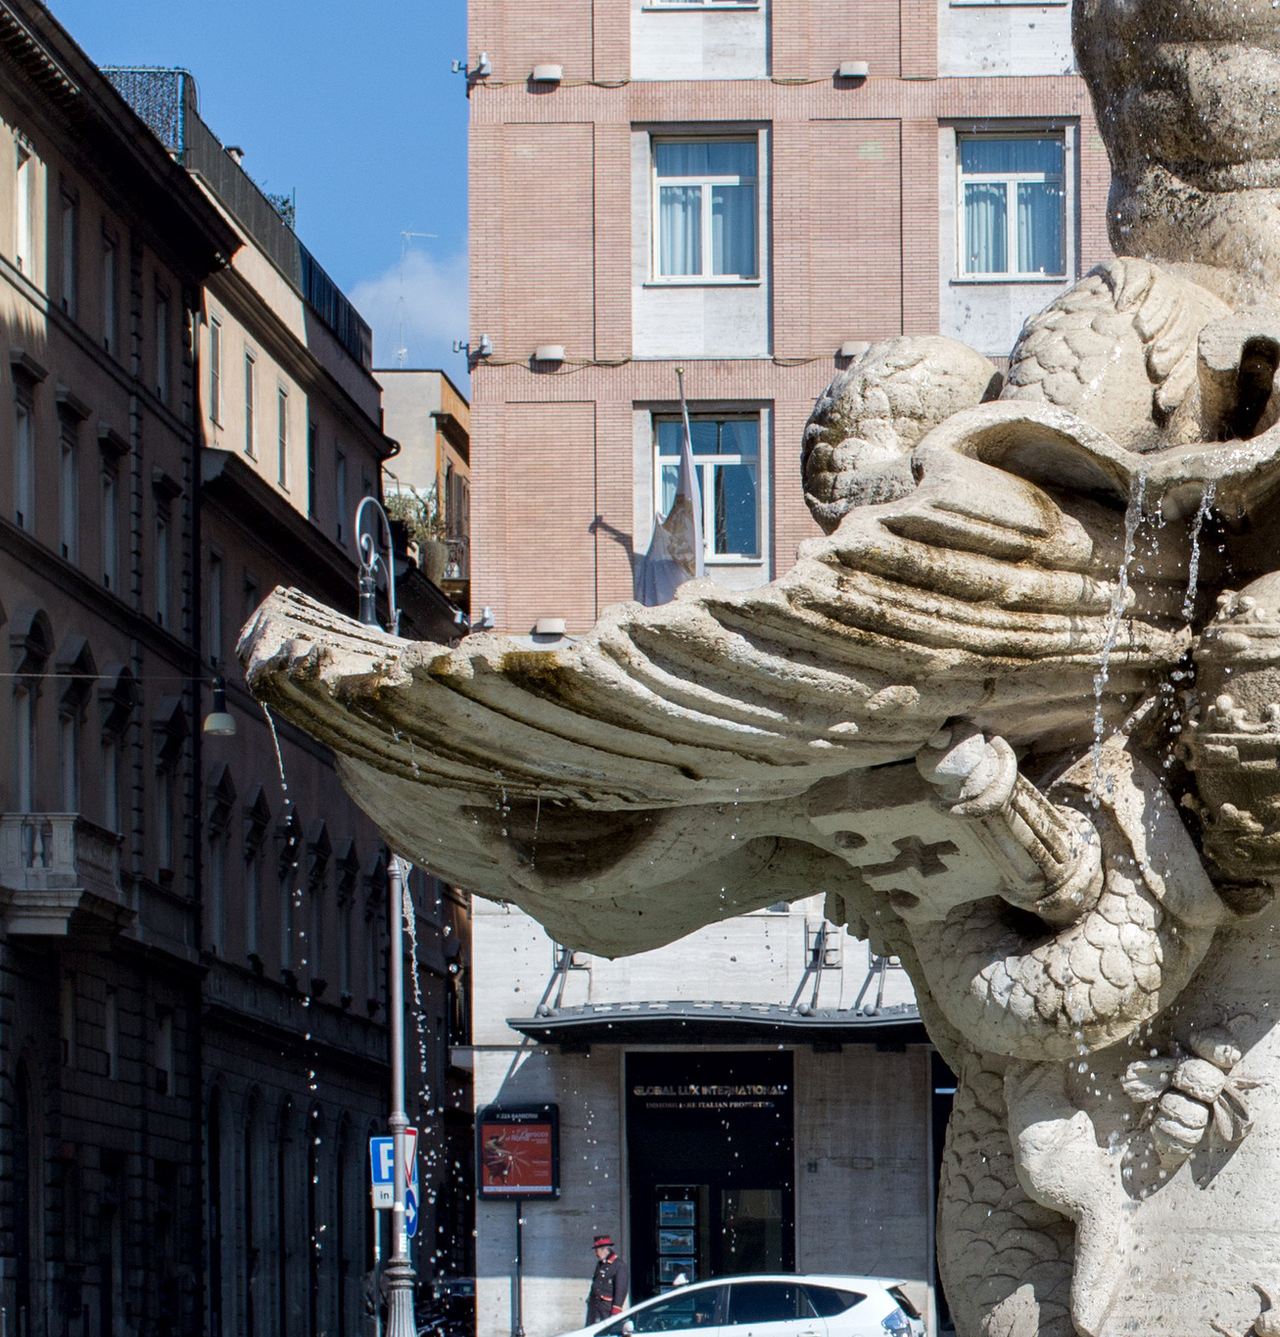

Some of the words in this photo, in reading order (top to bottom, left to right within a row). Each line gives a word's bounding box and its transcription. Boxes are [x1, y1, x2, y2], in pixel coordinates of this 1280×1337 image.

[633, 1085, 676, 1096] GLOBAL
[678, 1085, 699, 1096] LUX
[701, 1085, 785, 1096] INTERNATIONAL
[699, 1101, 728, 1109] ITALIAN
